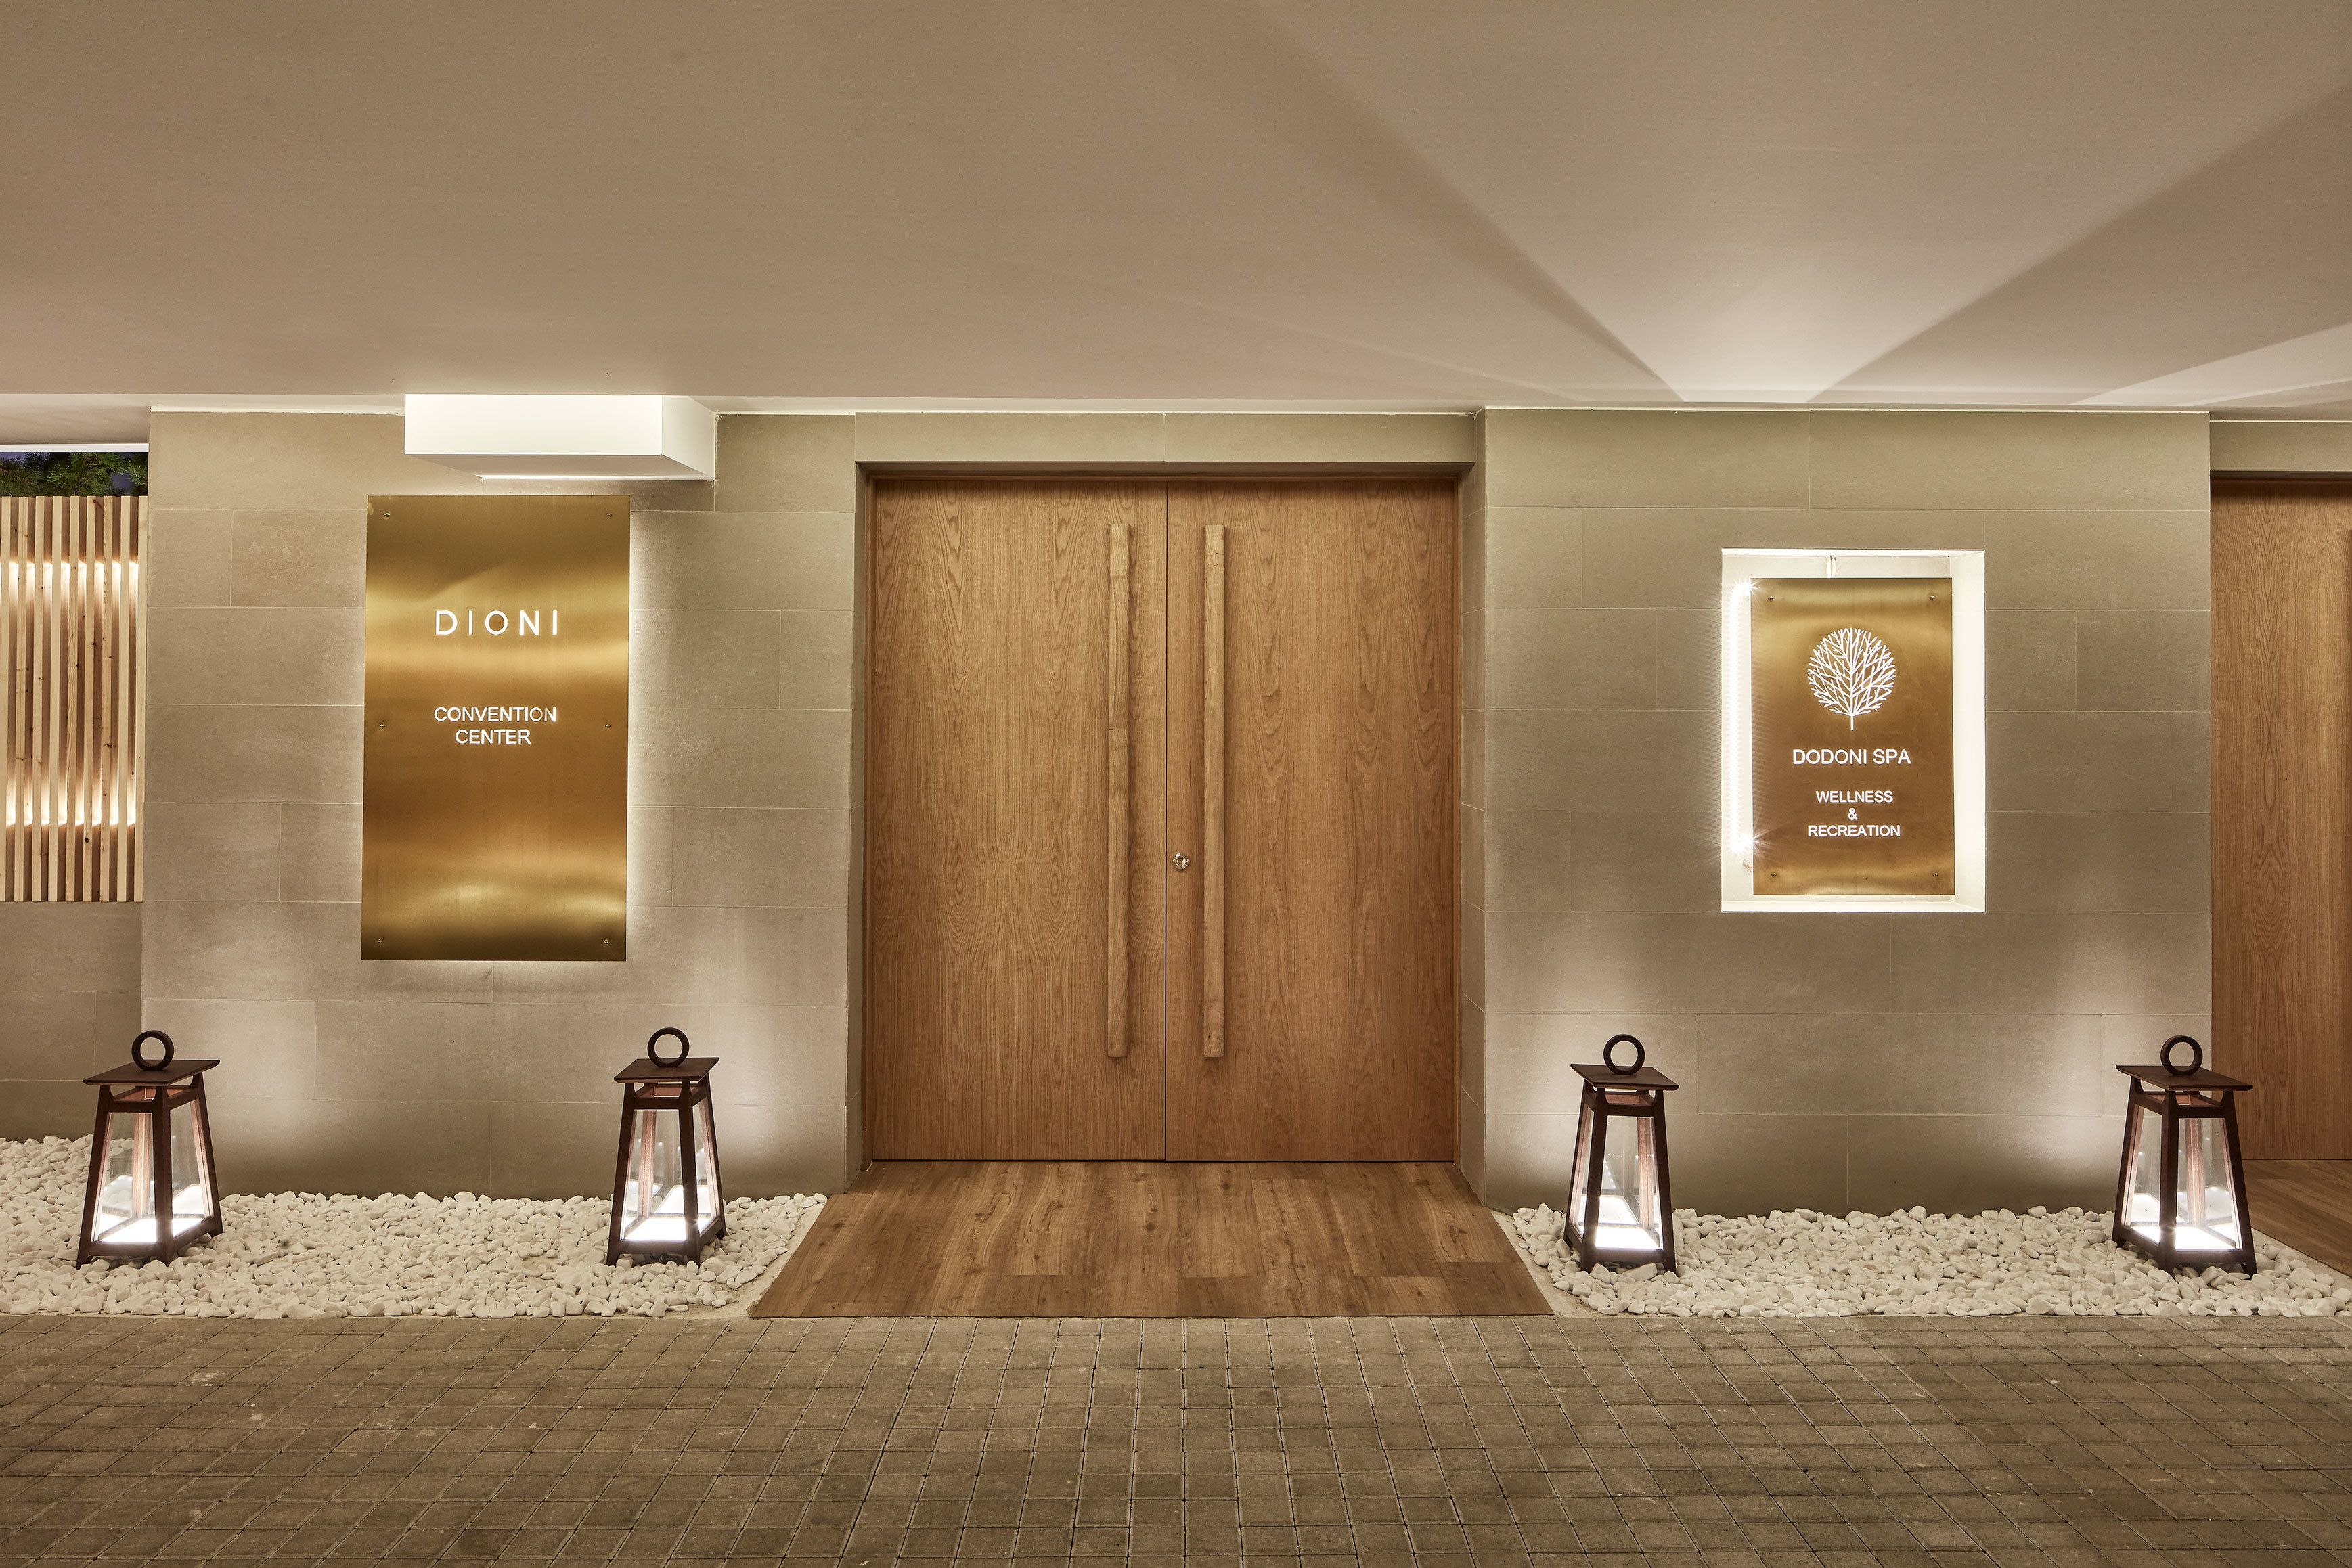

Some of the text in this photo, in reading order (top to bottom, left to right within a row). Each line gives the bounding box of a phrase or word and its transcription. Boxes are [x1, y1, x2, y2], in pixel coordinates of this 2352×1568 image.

[435, 610, 558, 635] DIONI
[434, 706, 557, 723] CONVENTION
[455, 729, 531, 744] CENTER
[1792, 748, 1911, 765] DODONI SPA
[1815, 790, 1894, 803] WELLNESS
[1848, 807, 1858, 820] &
[1808, 824, 1901, 837] RECREATION
